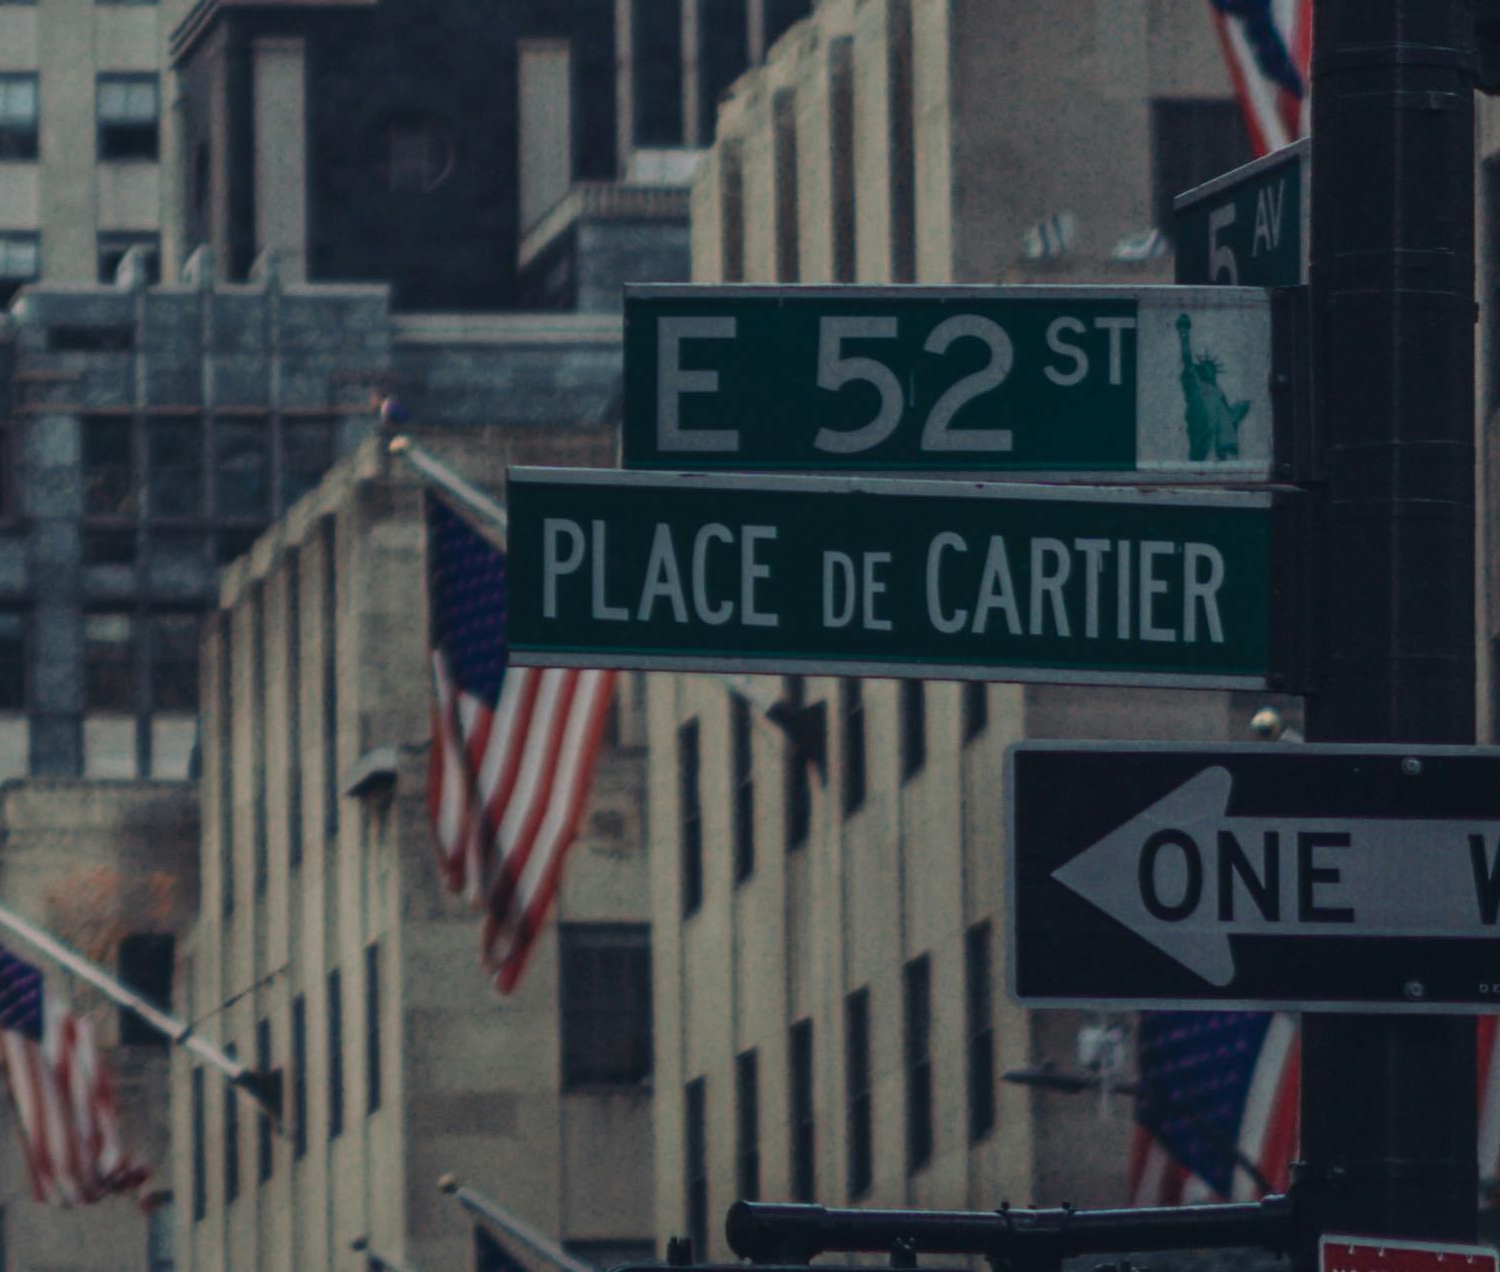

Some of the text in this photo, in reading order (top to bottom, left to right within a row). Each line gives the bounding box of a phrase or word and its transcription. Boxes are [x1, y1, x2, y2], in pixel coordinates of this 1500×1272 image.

[1251, 179, 1284, 258] AV
[657, 313, 1136, 454] E 52 ST
[543, 517, 1225, 643] PLACE DE CARTIER
[1138, 828, 1355, 923] ONE
